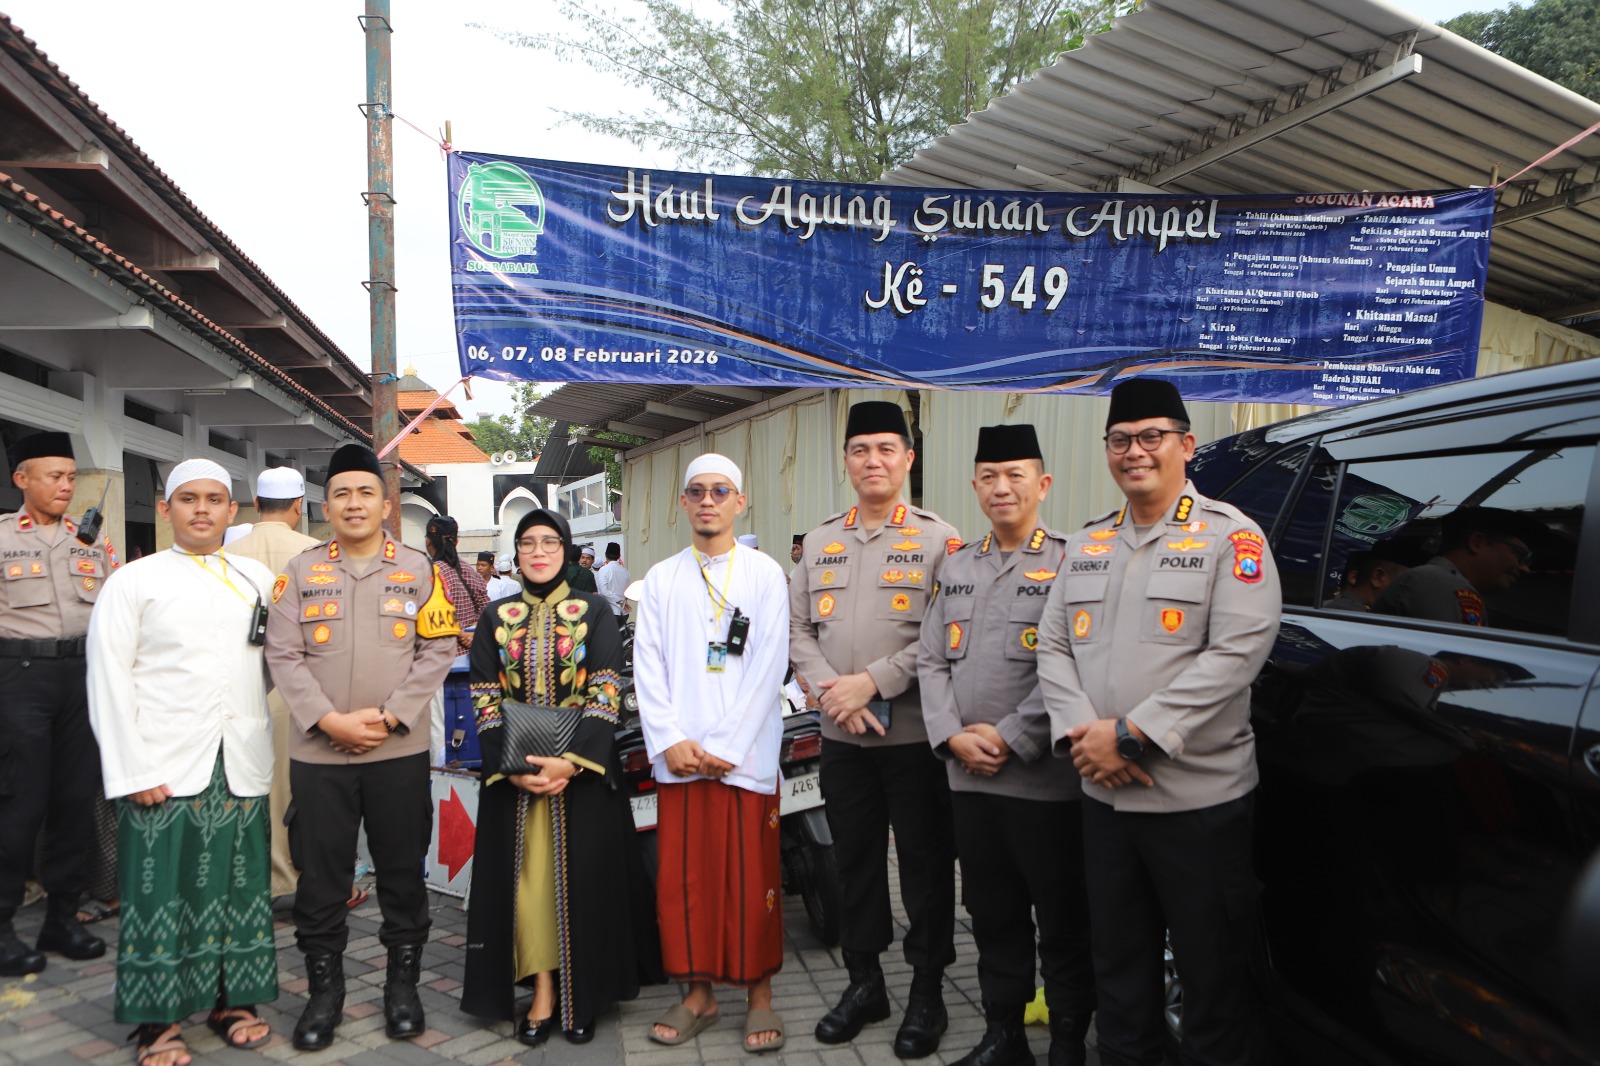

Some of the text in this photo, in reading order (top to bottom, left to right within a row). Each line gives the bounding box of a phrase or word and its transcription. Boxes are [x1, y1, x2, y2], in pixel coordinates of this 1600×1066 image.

[606, 169, 721, 228] Haul
[735, 185, 898, 243] Agung
[1295, 193, 1436, 209] SUSUNAN ACARA
[1245, 211, 1345, 224] Tahlil (khusus Muslimat)
[1363, 214, 1435, 225] Tahlil Akbar dan
[1360, 226, 1490, 240] Sekilas Sejarah Sunan Ampel
[1233, 251, 1374, 267] Pengajian umum (khusus Muslimat)
[1386, 262, 1457, 274] Pengajian Umum
[980, 263, 1069, 310] 549
[1385, 276, 1476, 289] Sejarah Sunan Ampel
[1205, 286, 1244, 296] Khataman
[1283, 290, 1295, 298] Bil
[1296, 290, 1319, 299] Ghoib
[1355, 309, 1439, 323] Khitanan Massal
[1210, 322, 1236, 332] Kirab
[1344, 322, 1360, 331] Hari
[1377, 324, 1403, 333] Minggu
[1198, 342, 1223, 350] Tanggal
[1343, 334, 1369, 343] Tanggal
[1385, 335, 1415, 344] Februari
[1416, 337, 1433, 345] 2026
[468, 344, 719, 365] 06, 07, 08 Februari 2026
[1323, 361, 1441, 375] Pembacaan Sholawat Nabi dan
[1322, 373, 1382, 385] Hadrah ISHARI
[70, 547, 101, 558] POLRI
[886, 553, 924, 564] POLRI
[1159, 556, 1204, 569] POLRI
[301, 585, 418, 598] WAHYU H POLRI
[945, 584, 975, 597] BAYU
